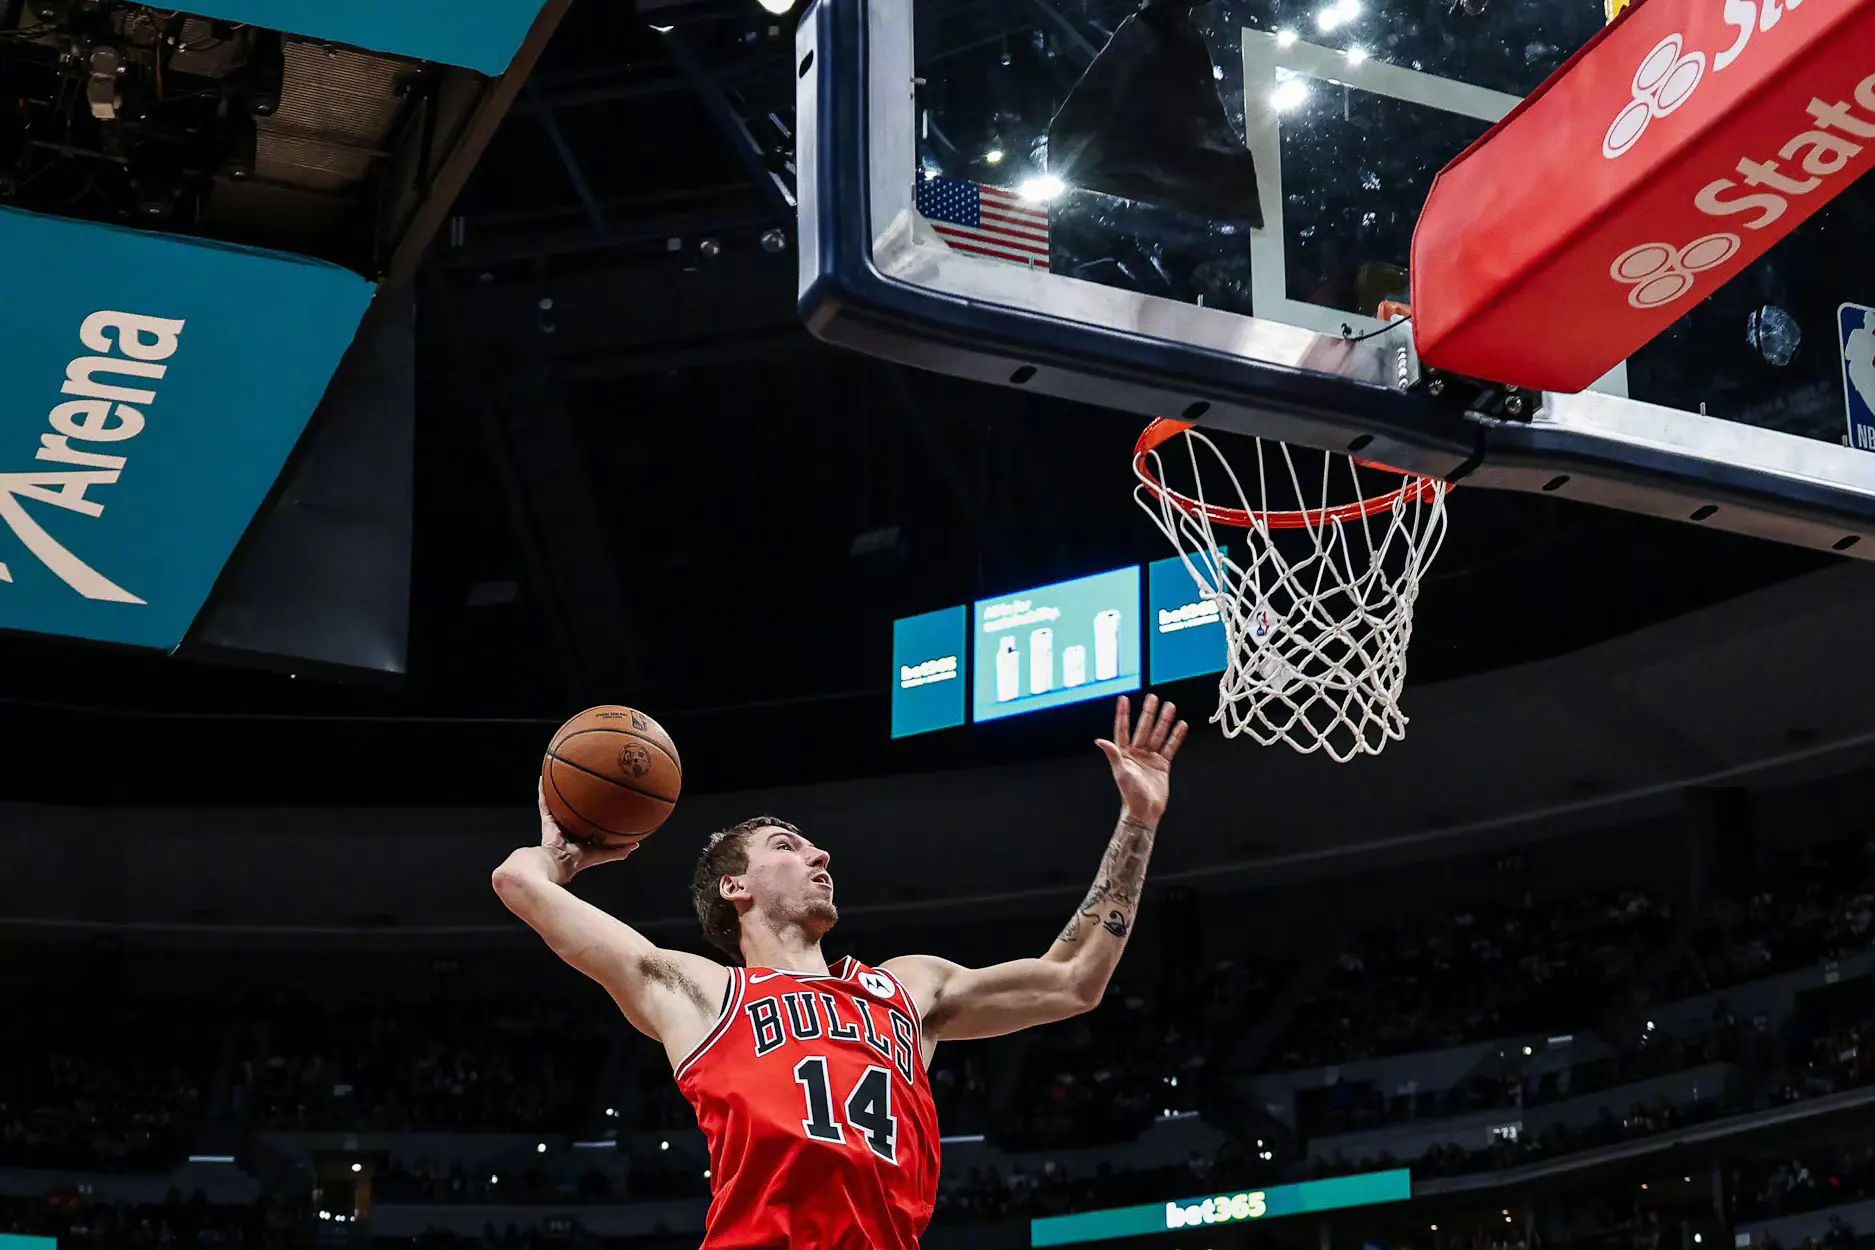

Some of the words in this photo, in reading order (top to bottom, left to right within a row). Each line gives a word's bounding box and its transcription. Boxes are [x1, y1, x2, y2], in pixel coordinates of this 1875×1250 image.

[0, 310, 185, 518] Arena
[1857, 423, 1875, 449] NB
[745, 992, 914, 1085] BULLS
[793, 1055, 898, 1166] 14
[1166, 1191, 1266, 1228] bet365
